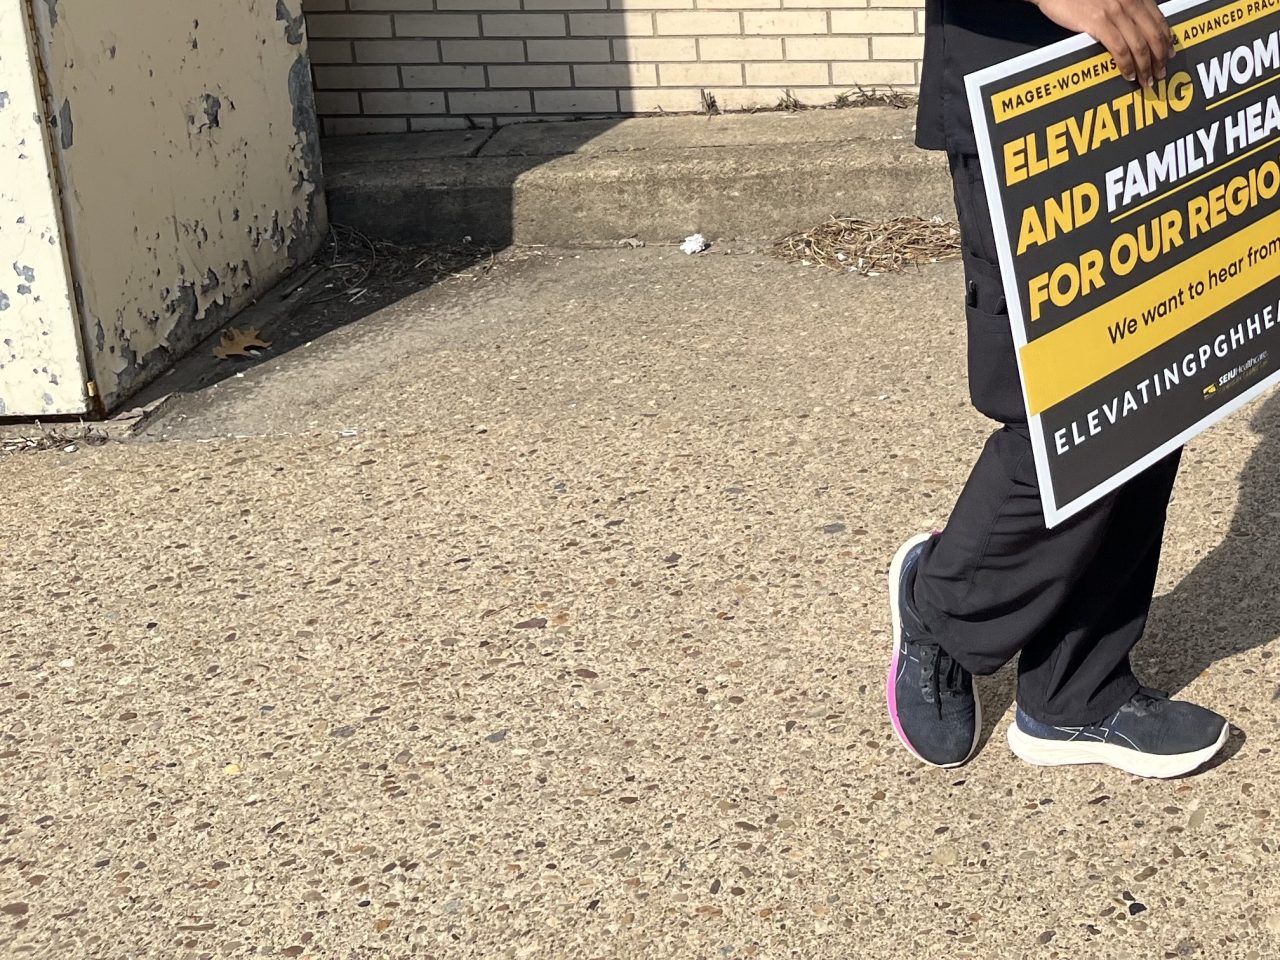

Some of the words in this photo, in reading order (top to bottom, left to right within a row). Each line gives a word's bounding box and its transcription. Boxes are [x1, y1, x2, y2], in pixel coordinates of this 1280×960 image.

[1002, 58, 1117, 112] MAGEE-WOMENS
[1183, 8, 1244, 42] ADVANCED
[1003, 71, 1194, 186] ELEVATING
[1016, 181, 1100, 256] AND
[1105, 121, 1220, 213] FAMILY
[1028, 249, 1106, 322] FOR
[1109, 209, 1184, 277] OUR
[1107, 316, 1138, 345] We
[1142, 295, 1185, 327] want
[1188, 280, 1204, 300] to
[1208, 257, 1243, 290] hear
